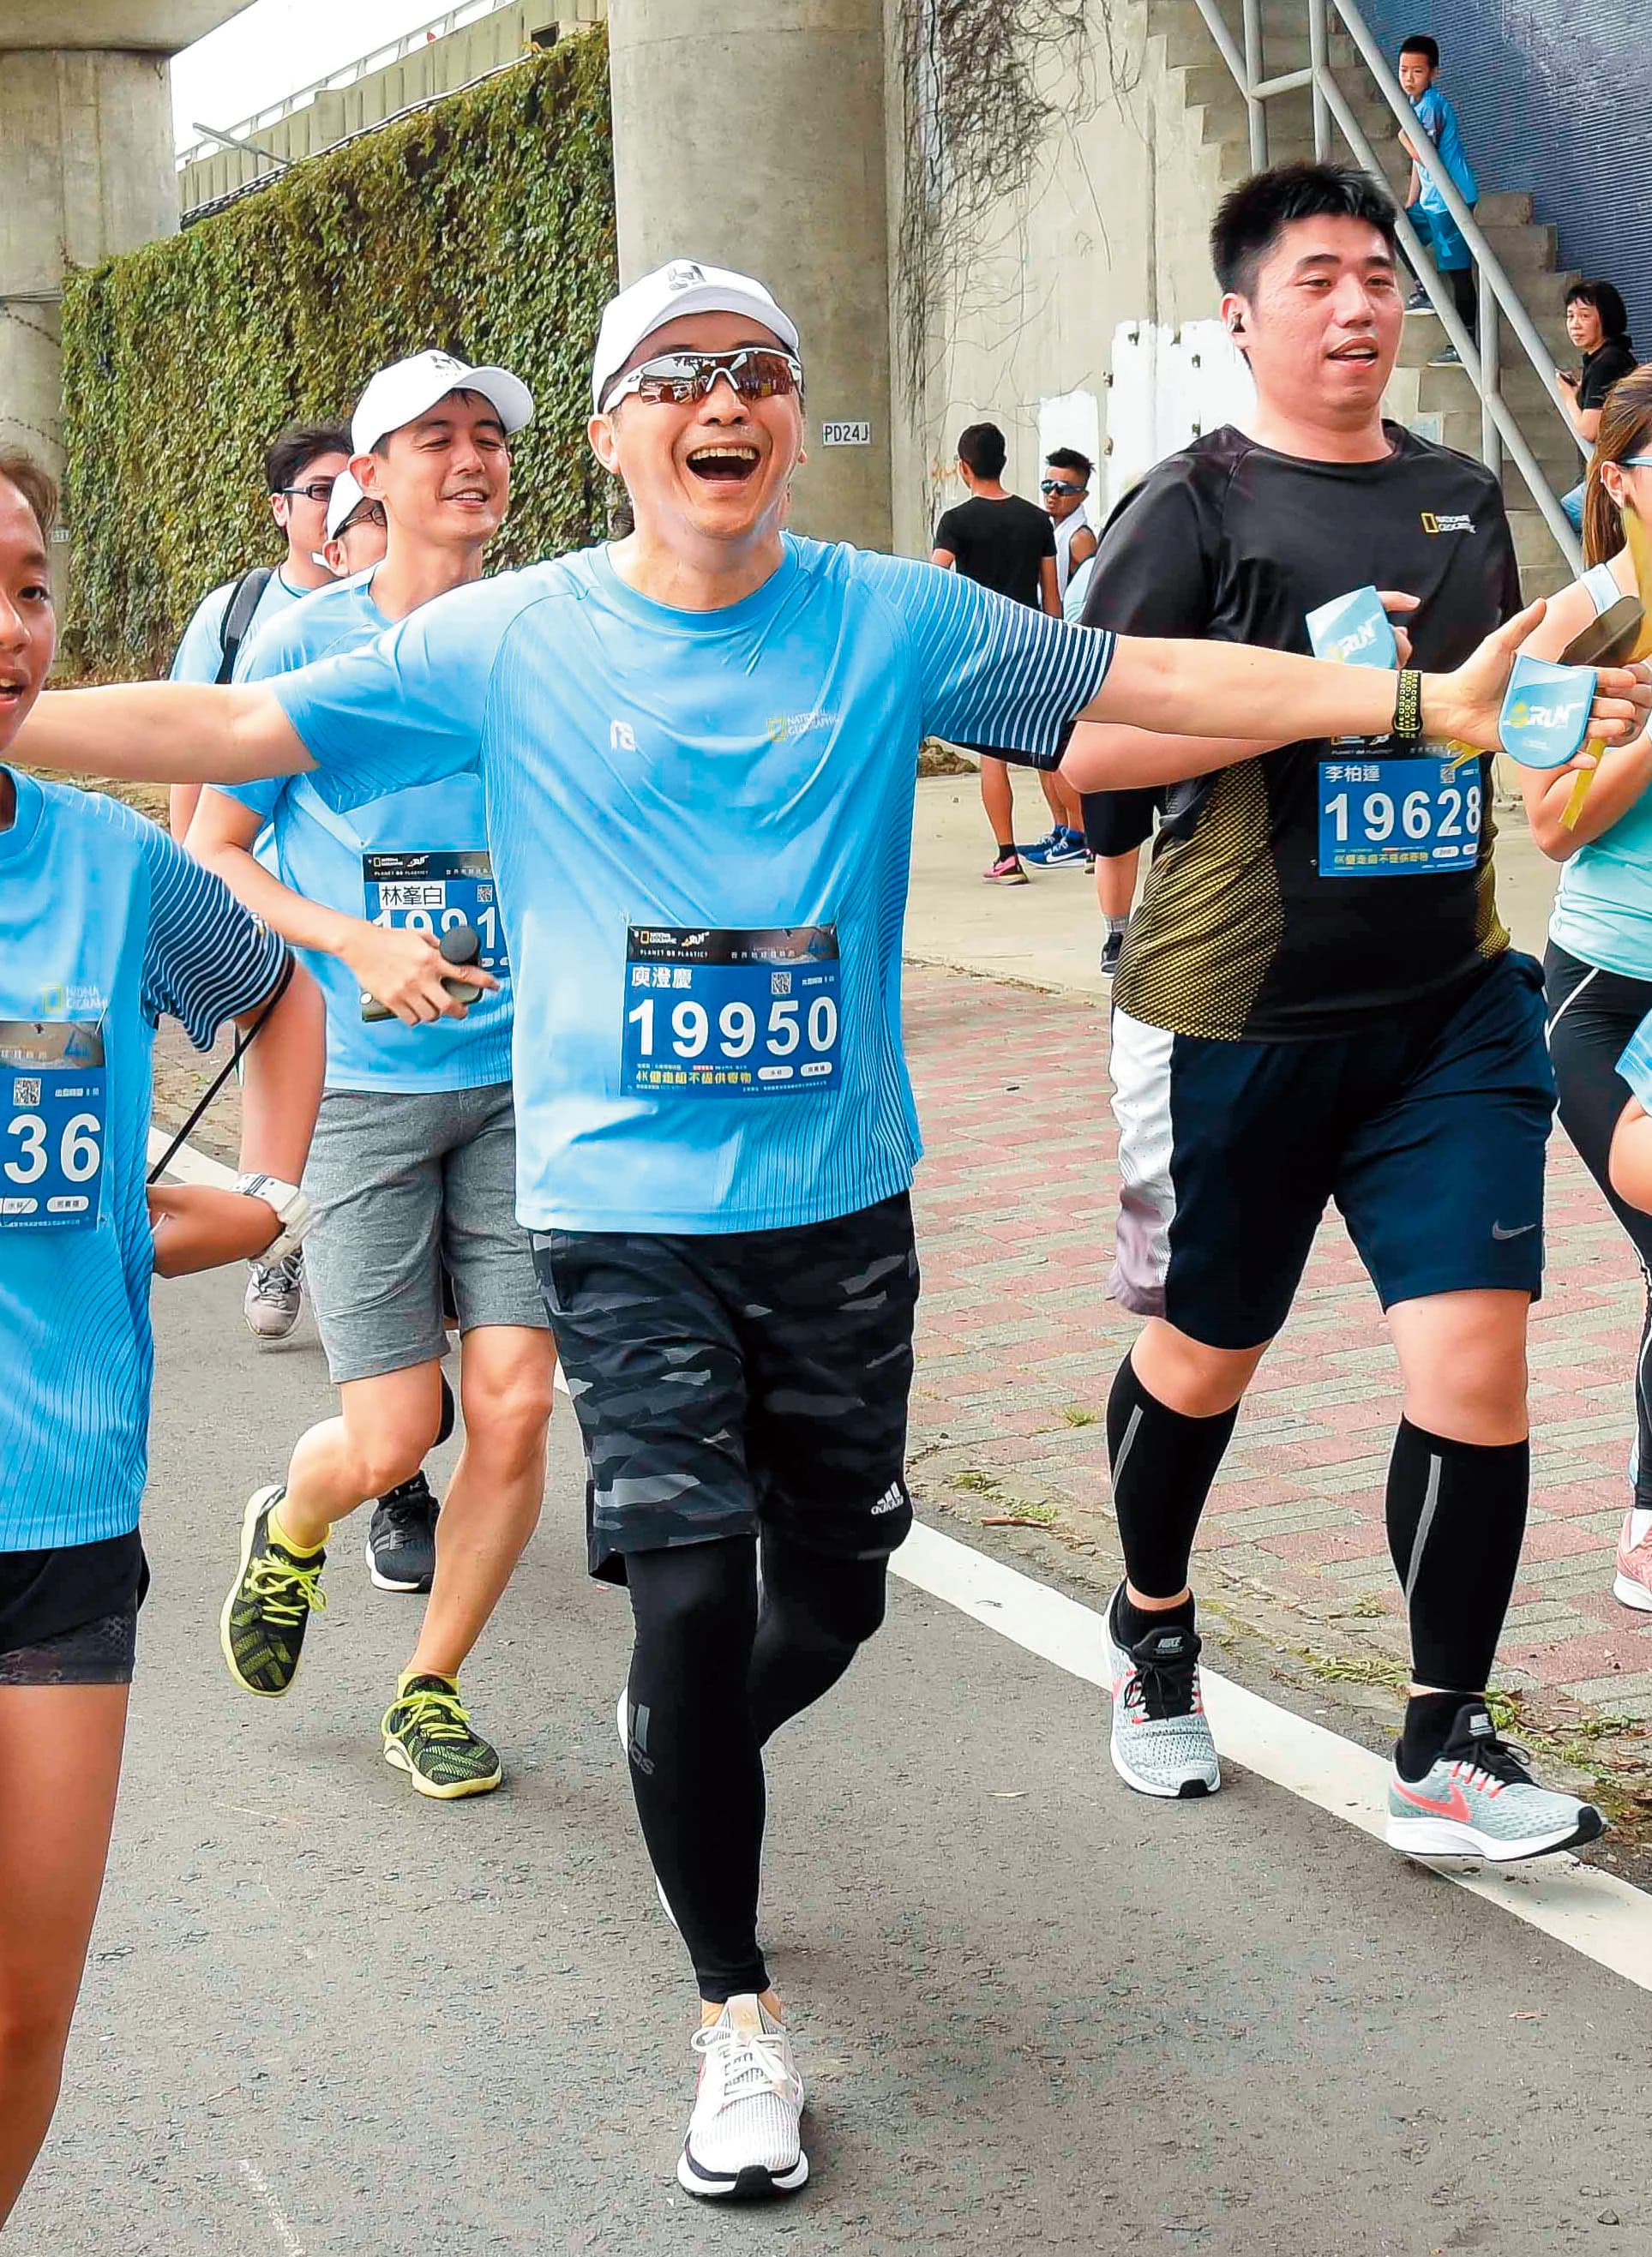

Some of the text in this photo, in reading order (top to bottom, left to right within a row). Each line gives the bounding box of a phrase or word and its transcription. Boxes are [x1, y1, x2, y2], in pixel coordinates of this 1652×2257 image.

[1325, 786, 1481, 841] 19628
[628, 996, 838, 1058] 19950
[3, 1113, 101, 1184] 36
